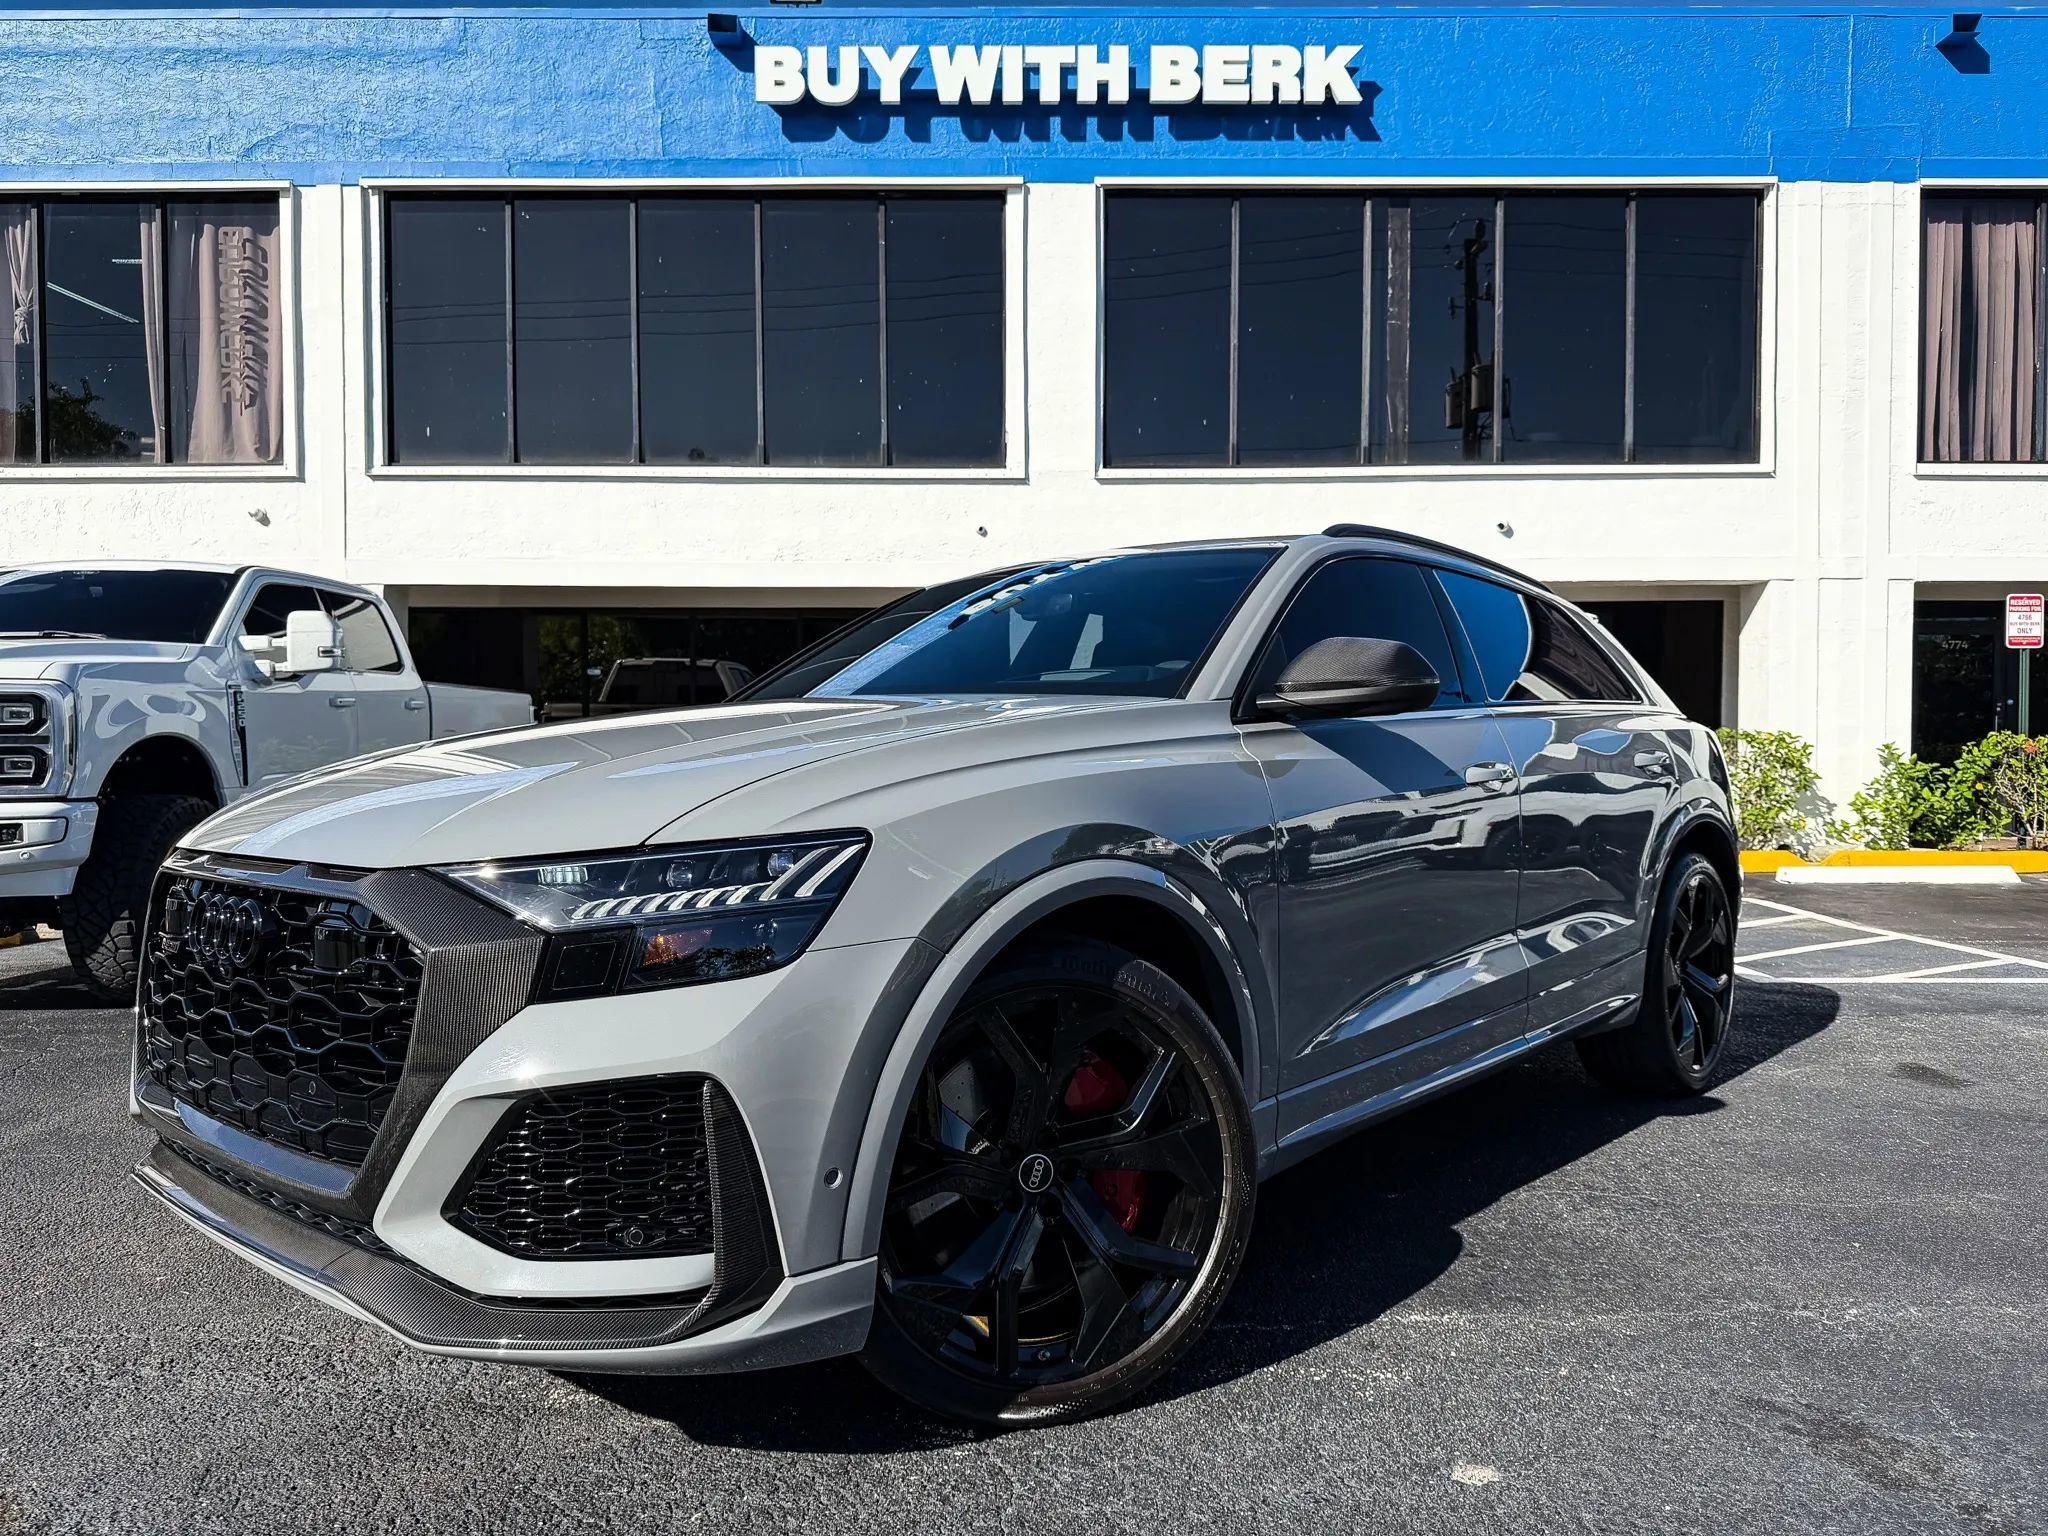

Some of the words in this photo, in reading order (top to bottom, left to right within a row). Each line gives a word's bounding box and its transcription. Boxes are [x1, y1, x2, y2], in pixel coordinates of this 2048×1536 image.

[755, 45, 919, 107] BUY
[929, 45, 1130, 106] WITH
[1149, 45, 1363, 107] BERK
[1941, 640, 1969, 649] 4774
